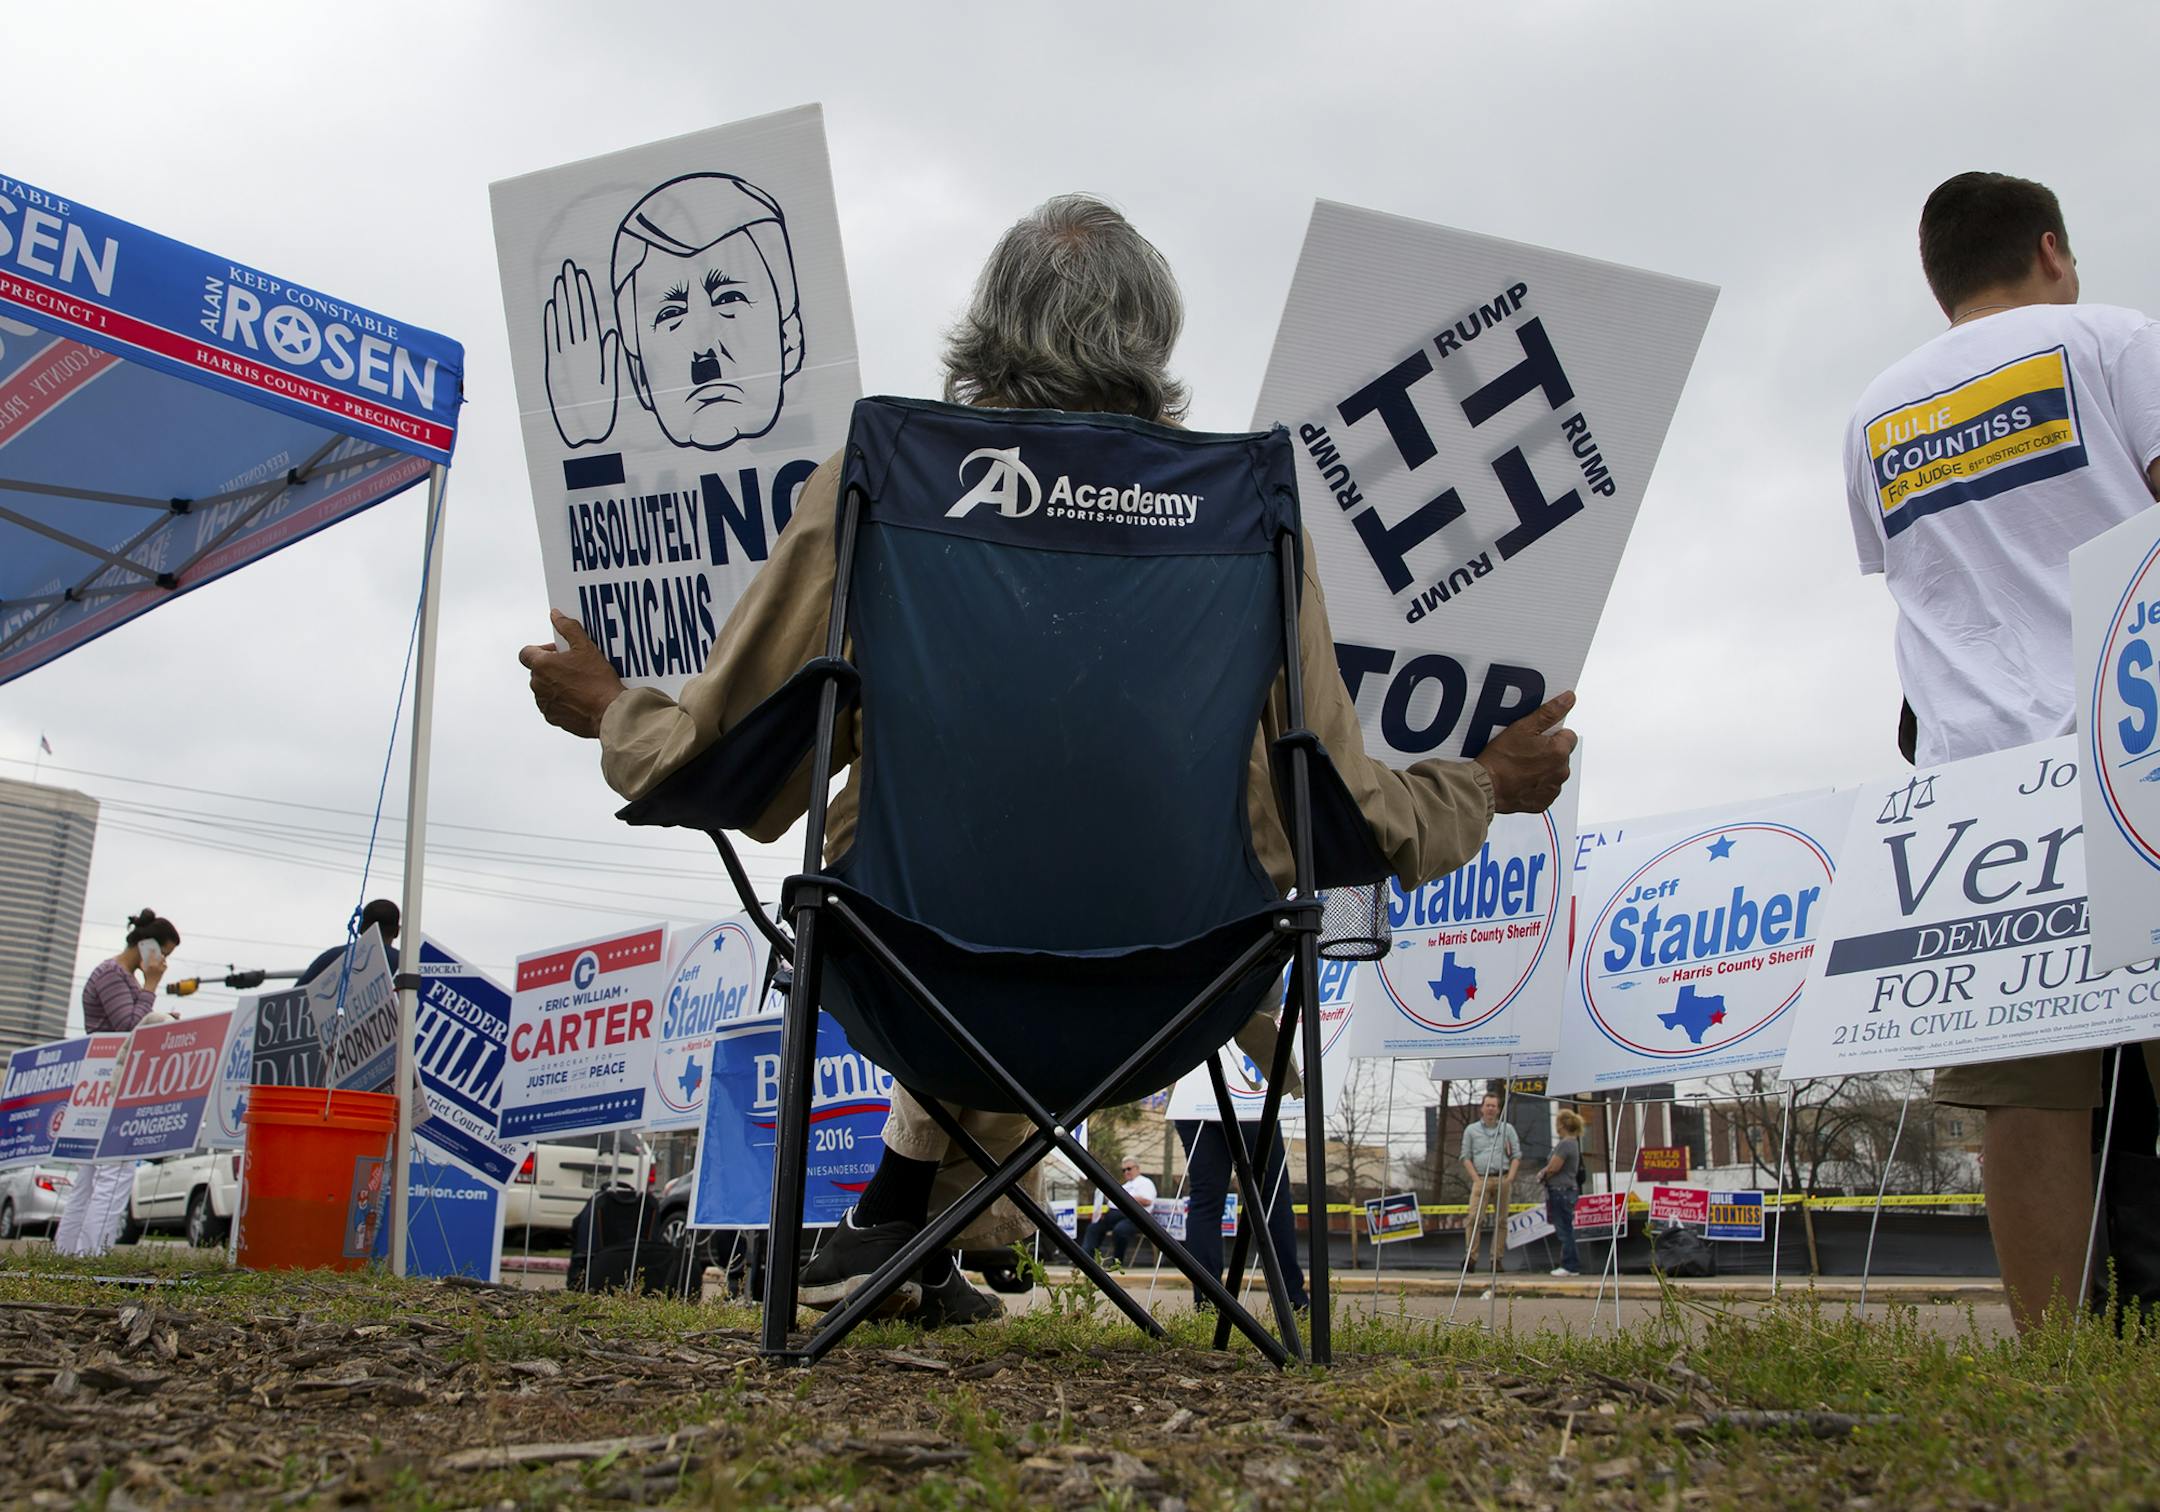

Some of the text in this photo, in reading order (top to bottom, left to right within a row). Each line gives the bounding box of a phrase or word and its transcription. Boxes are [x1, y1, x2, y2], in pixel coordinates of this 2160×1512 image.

[0, 279, 108, 328] PRECINCT 1
[200, 275, 225, 336] ALAN
[229, 266, 399, 340] KEEP CONSTABLE
[1432, 281, 1529, 359] RUMP
[221, 284, 438, 411] ROSEN
[196, 349, 260, 382] HARRIS
[263, 373, 330, 405] COUNTY
[344, 403, 421, 435] PRECINCT
[424, 427, 431, 440] 1
[1560, 411, 1617, 498] RUMP
[1879, 406, 1953, 450] JULIE
[1881, 405, 2032, 481] COUNTISS
[1299, 421, 1364, 512] RUMP
[1888, 479, 1908, 503] FOR
[1914, 462, 1963, 489] JUDGE
[1985, 440, 2031, 465] DISTRICT
[2033, 429, 2068, 448] COURT
[1048, 475, 1199, 523] Academy
[568, 489, 701, 572] ABSOLUTELY
[1405, 551, 1495, 625] RUMP
[578, 572, 716, 679] MEXICANS
[1388, 842, 1546, 928] Stauber
[1626, 878, 1680, 903] Jeff
[1428, 921, 1541, 948] for Harris County Sheriff
[1603, 886, 1821, 973] Stauber
[678, 964, 701, 983] Jeff
[1658, 944, 1815, 985] for Harris County Sheriff
[1868, 963, 1977, 1014] FOR
[353, 971, 391, 1019] ELLIOTT
[426, 979, 508, 1043] FREDER
[545, 985, 621, 1012] ERIC WILLIAM
[664, 977, 748, 1040] Stauber
[1832, 1014, 1900, 1046] 215th
[1910, 1007, 1978, 1038] CIVIL
[1985, 987, 2120, 1028] DISTRICT
[161, 1031, 198, 1050] James
[511, 998, 654, 1062] CARTER
[118, 1047, 218, 1100] LLOYD
[526, 1071, 568, 1089] JUSTICE
[589, 1061, 626, 1078] PEACE
[541, 1052, 613, 1072] DEMOCRAT FOR
[753, 1053, 895, 1109] Brnie
[120, 1113, 189, 1138] CONGRESS
[452, 1109, 484, 1138] Court
[815, 1127, 855, 1152] 2016
[1643, 1150, 1680, 1160] WELLS
[1643, 1159, 1680, 1169] FARGO
